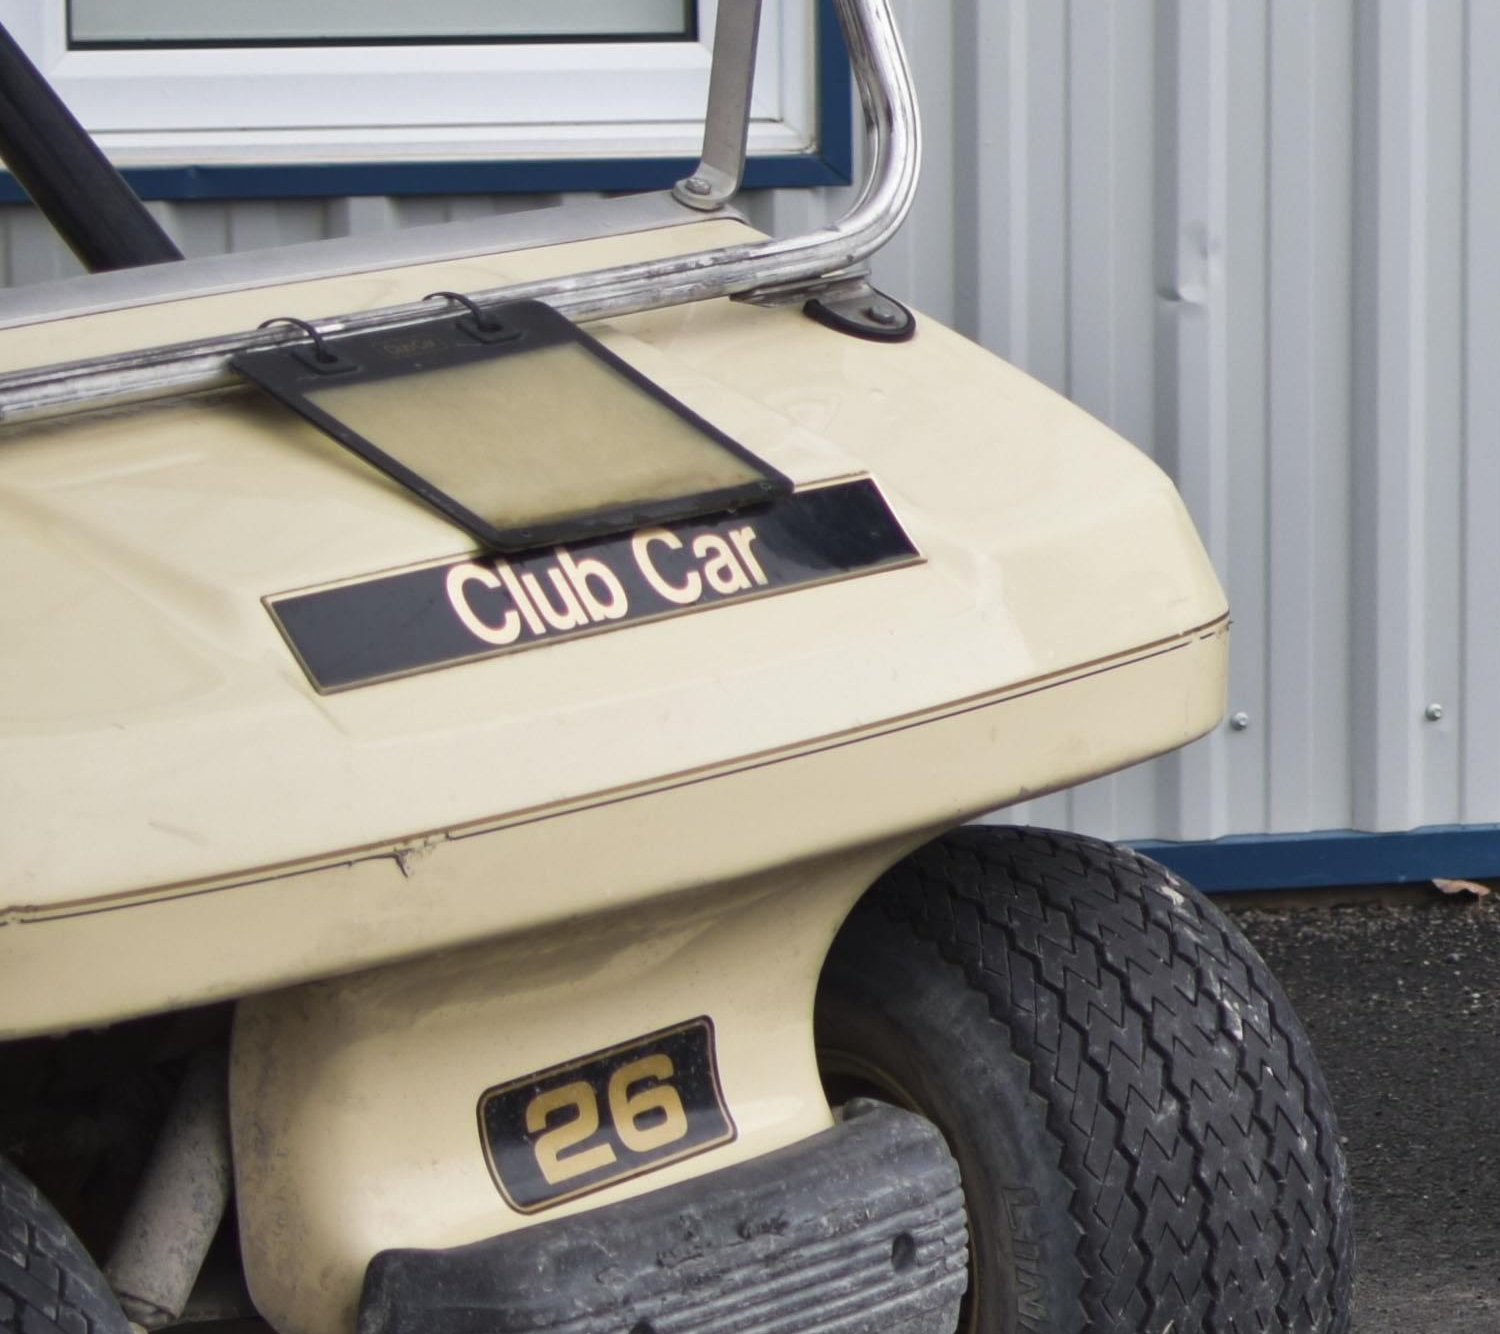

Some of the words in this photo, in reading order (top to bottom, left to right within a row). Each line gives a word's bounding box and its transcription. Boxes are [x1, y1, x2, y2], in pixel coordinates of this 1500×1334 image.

[446, 549, 628, 646] Club
[631, 525, 769, 606] Car
[526, 1053, 688, 1184] 26
